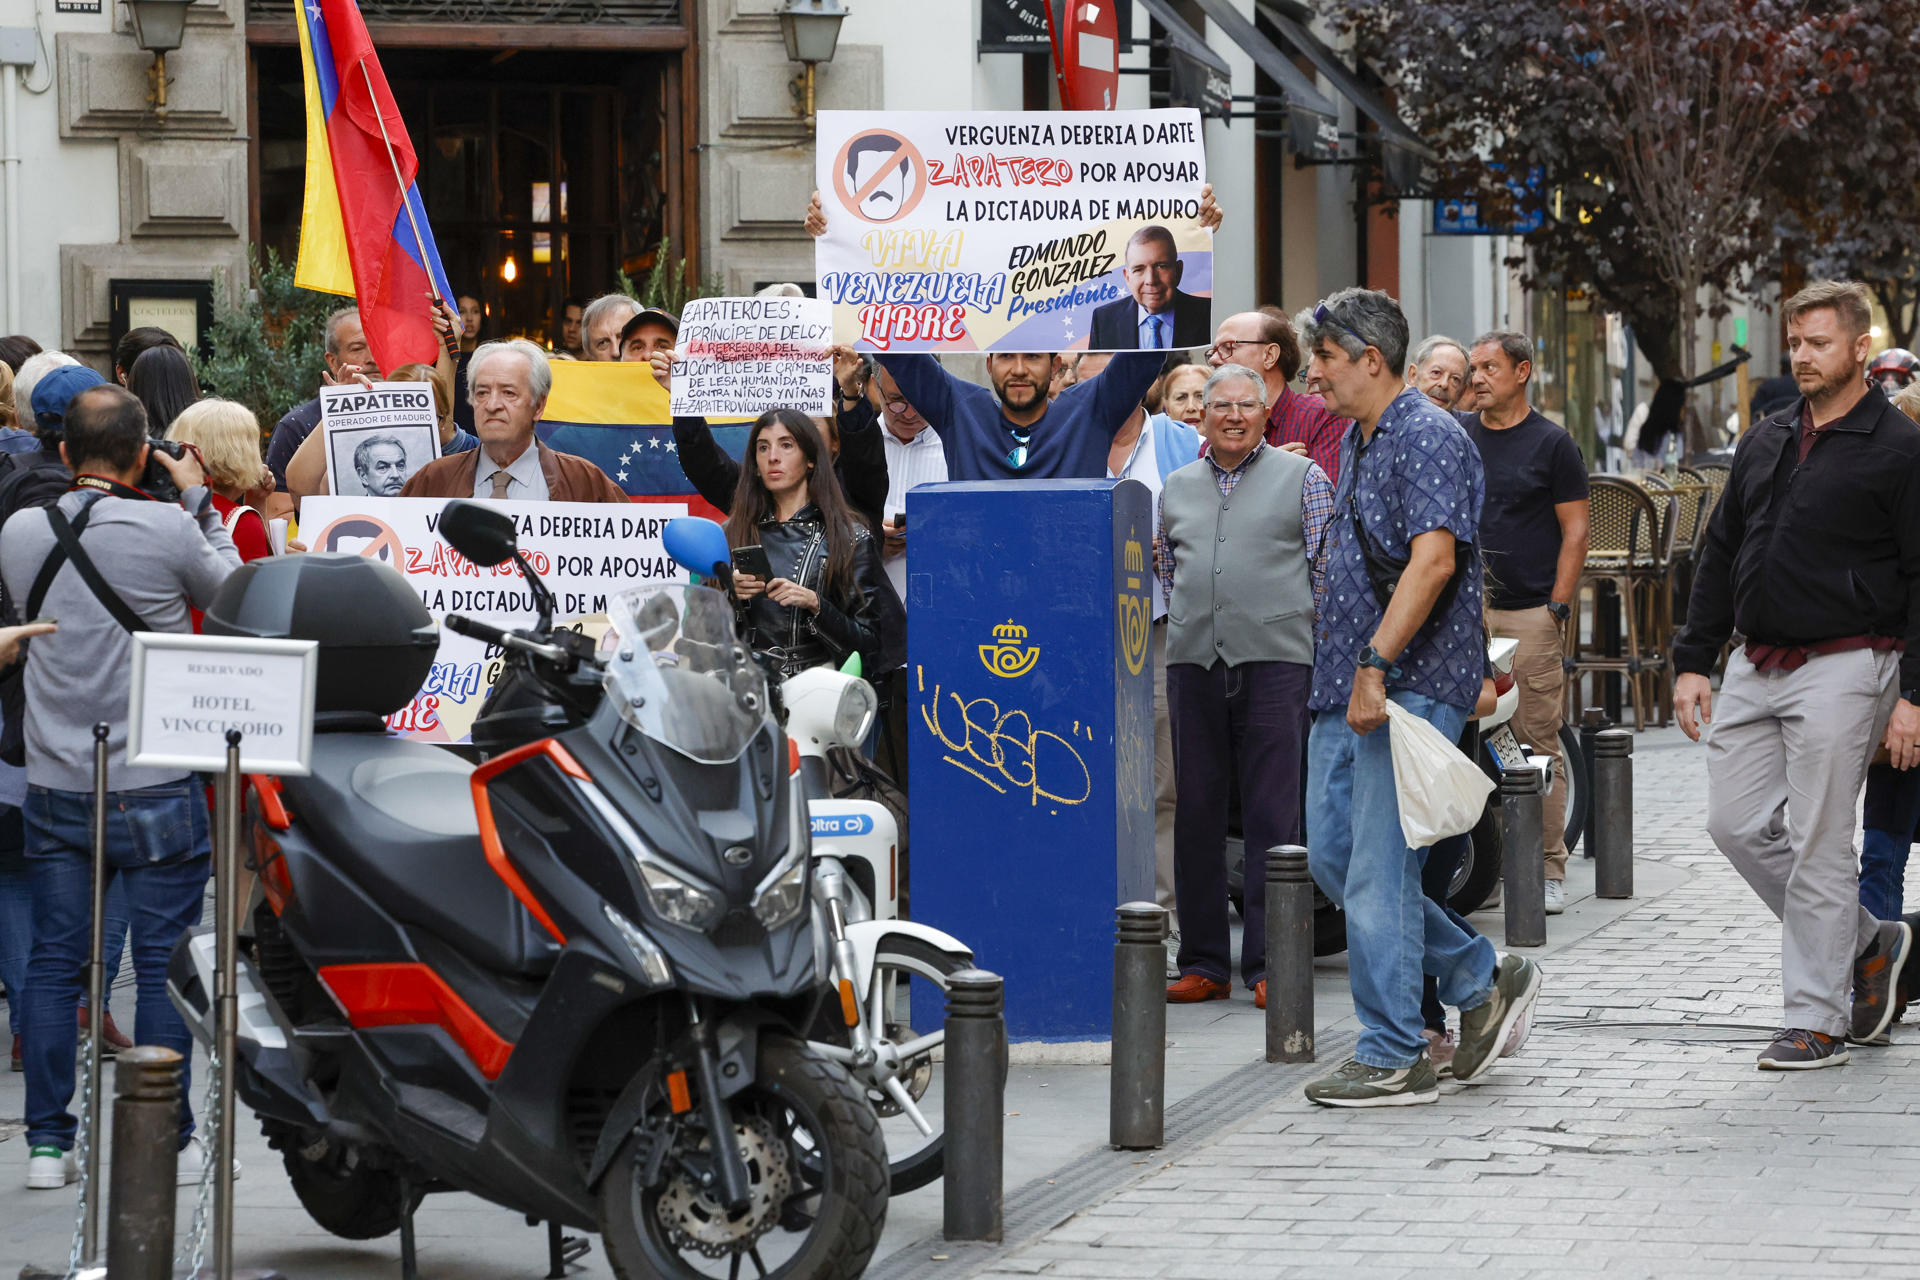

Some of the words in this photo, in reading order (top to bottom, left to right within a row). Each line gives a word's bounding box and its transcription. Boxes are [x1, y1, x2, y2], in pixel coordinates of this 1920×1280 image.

[945, 125, 1055, 146] VERGUENZA
[1061, 124, 1137, 145] DEBERIA
[1143, 122, 1195, 145] DARTE
[927, 153, 1073, 188] ZAPATERO
[1080, 162, 1116, 183] POR
[1123, 161, 1199, 183] APOYAR
[946, 200, 969, 222] LA
[975, 199, 1083, 222] DICTADURA
[1089, 199, 1110, 221] DE
[1116, 198, 1199, 221] MADURO
[860, 229, 965, 272] VIVA
[1008, 229, 1107, 270] EDMUNDO
[1012, 253, 1116, 296] GONZALEZ
[822, 272, 1006, 314] VENEZUELA
[1007, 282, 1118, 321] Presidente
[682, 300, 762, 324] ZAPATERO
[758, 326, 778, 340] DE
[858, 304, 966, 351] LIBRE
[689, 342, 705, 353] LA
[707, 341, 769, 354] REPRESORA
[774, 343, 799, 352] DEL
[762, 352, 778, 361] DE
[779, 350, 825, 363] MADURO
[689, 358, 753, 376] CÓMPLICE
[757, 361, 773, 373] DE
[775, 360, 831, 375] CRÍMENES
[687, 388, 730, 398] CONTRA
[689, 377, 705, 388] DE
[709, 376, 738, 387] LESA
[326, 393, 430, 414] ZAPATERO
[328, 416, 378, 428] OPERADOR
[380, 415, 392, 423] DE
[394, 413, 432, 422] MADURO
[77, 477, 112, 490] Canon
[540, 516, 615, 539] DEBERIA
[621, 518, 675, 540] DART
[557, 555, 593, 577] POR
[600, 556, 677, 579] APOYAR
[452, 590, 559, 614] DICTADUA
[565, 593, 586, 614] DE
[187, 664, 263, 677] RESERVADO
[191, 695, 256, 712] HOTEL
[161, 717, 226, 734] VINCCI
